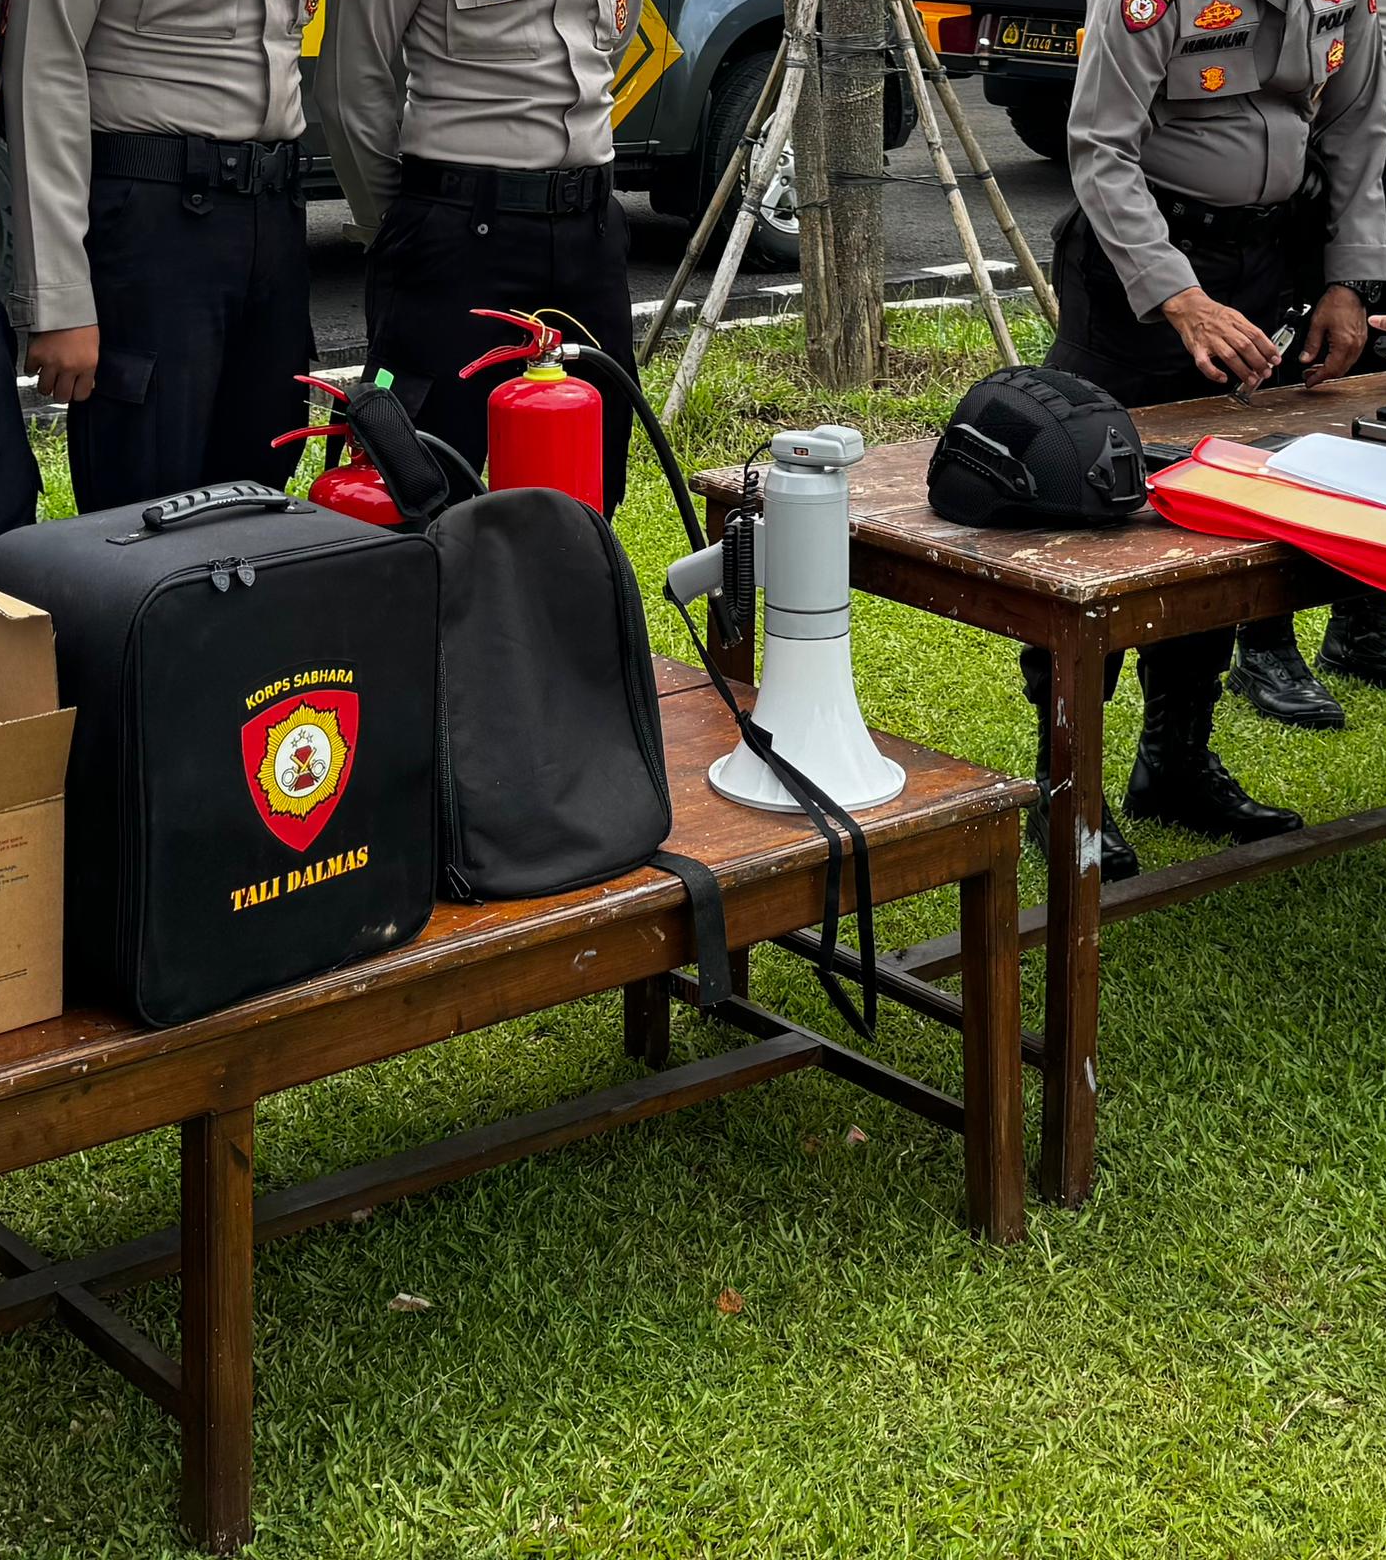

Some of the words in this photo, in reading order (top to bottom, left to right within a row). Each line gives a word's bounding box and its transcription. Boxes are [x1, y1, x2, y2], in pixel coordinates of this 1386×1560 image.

[245, 678, 291, 710] KORPS
[293, 669, 353, 688] SABHARA
[230, 876, 281, 912] TALI
[286, 845, 369, 893] DALMAS
